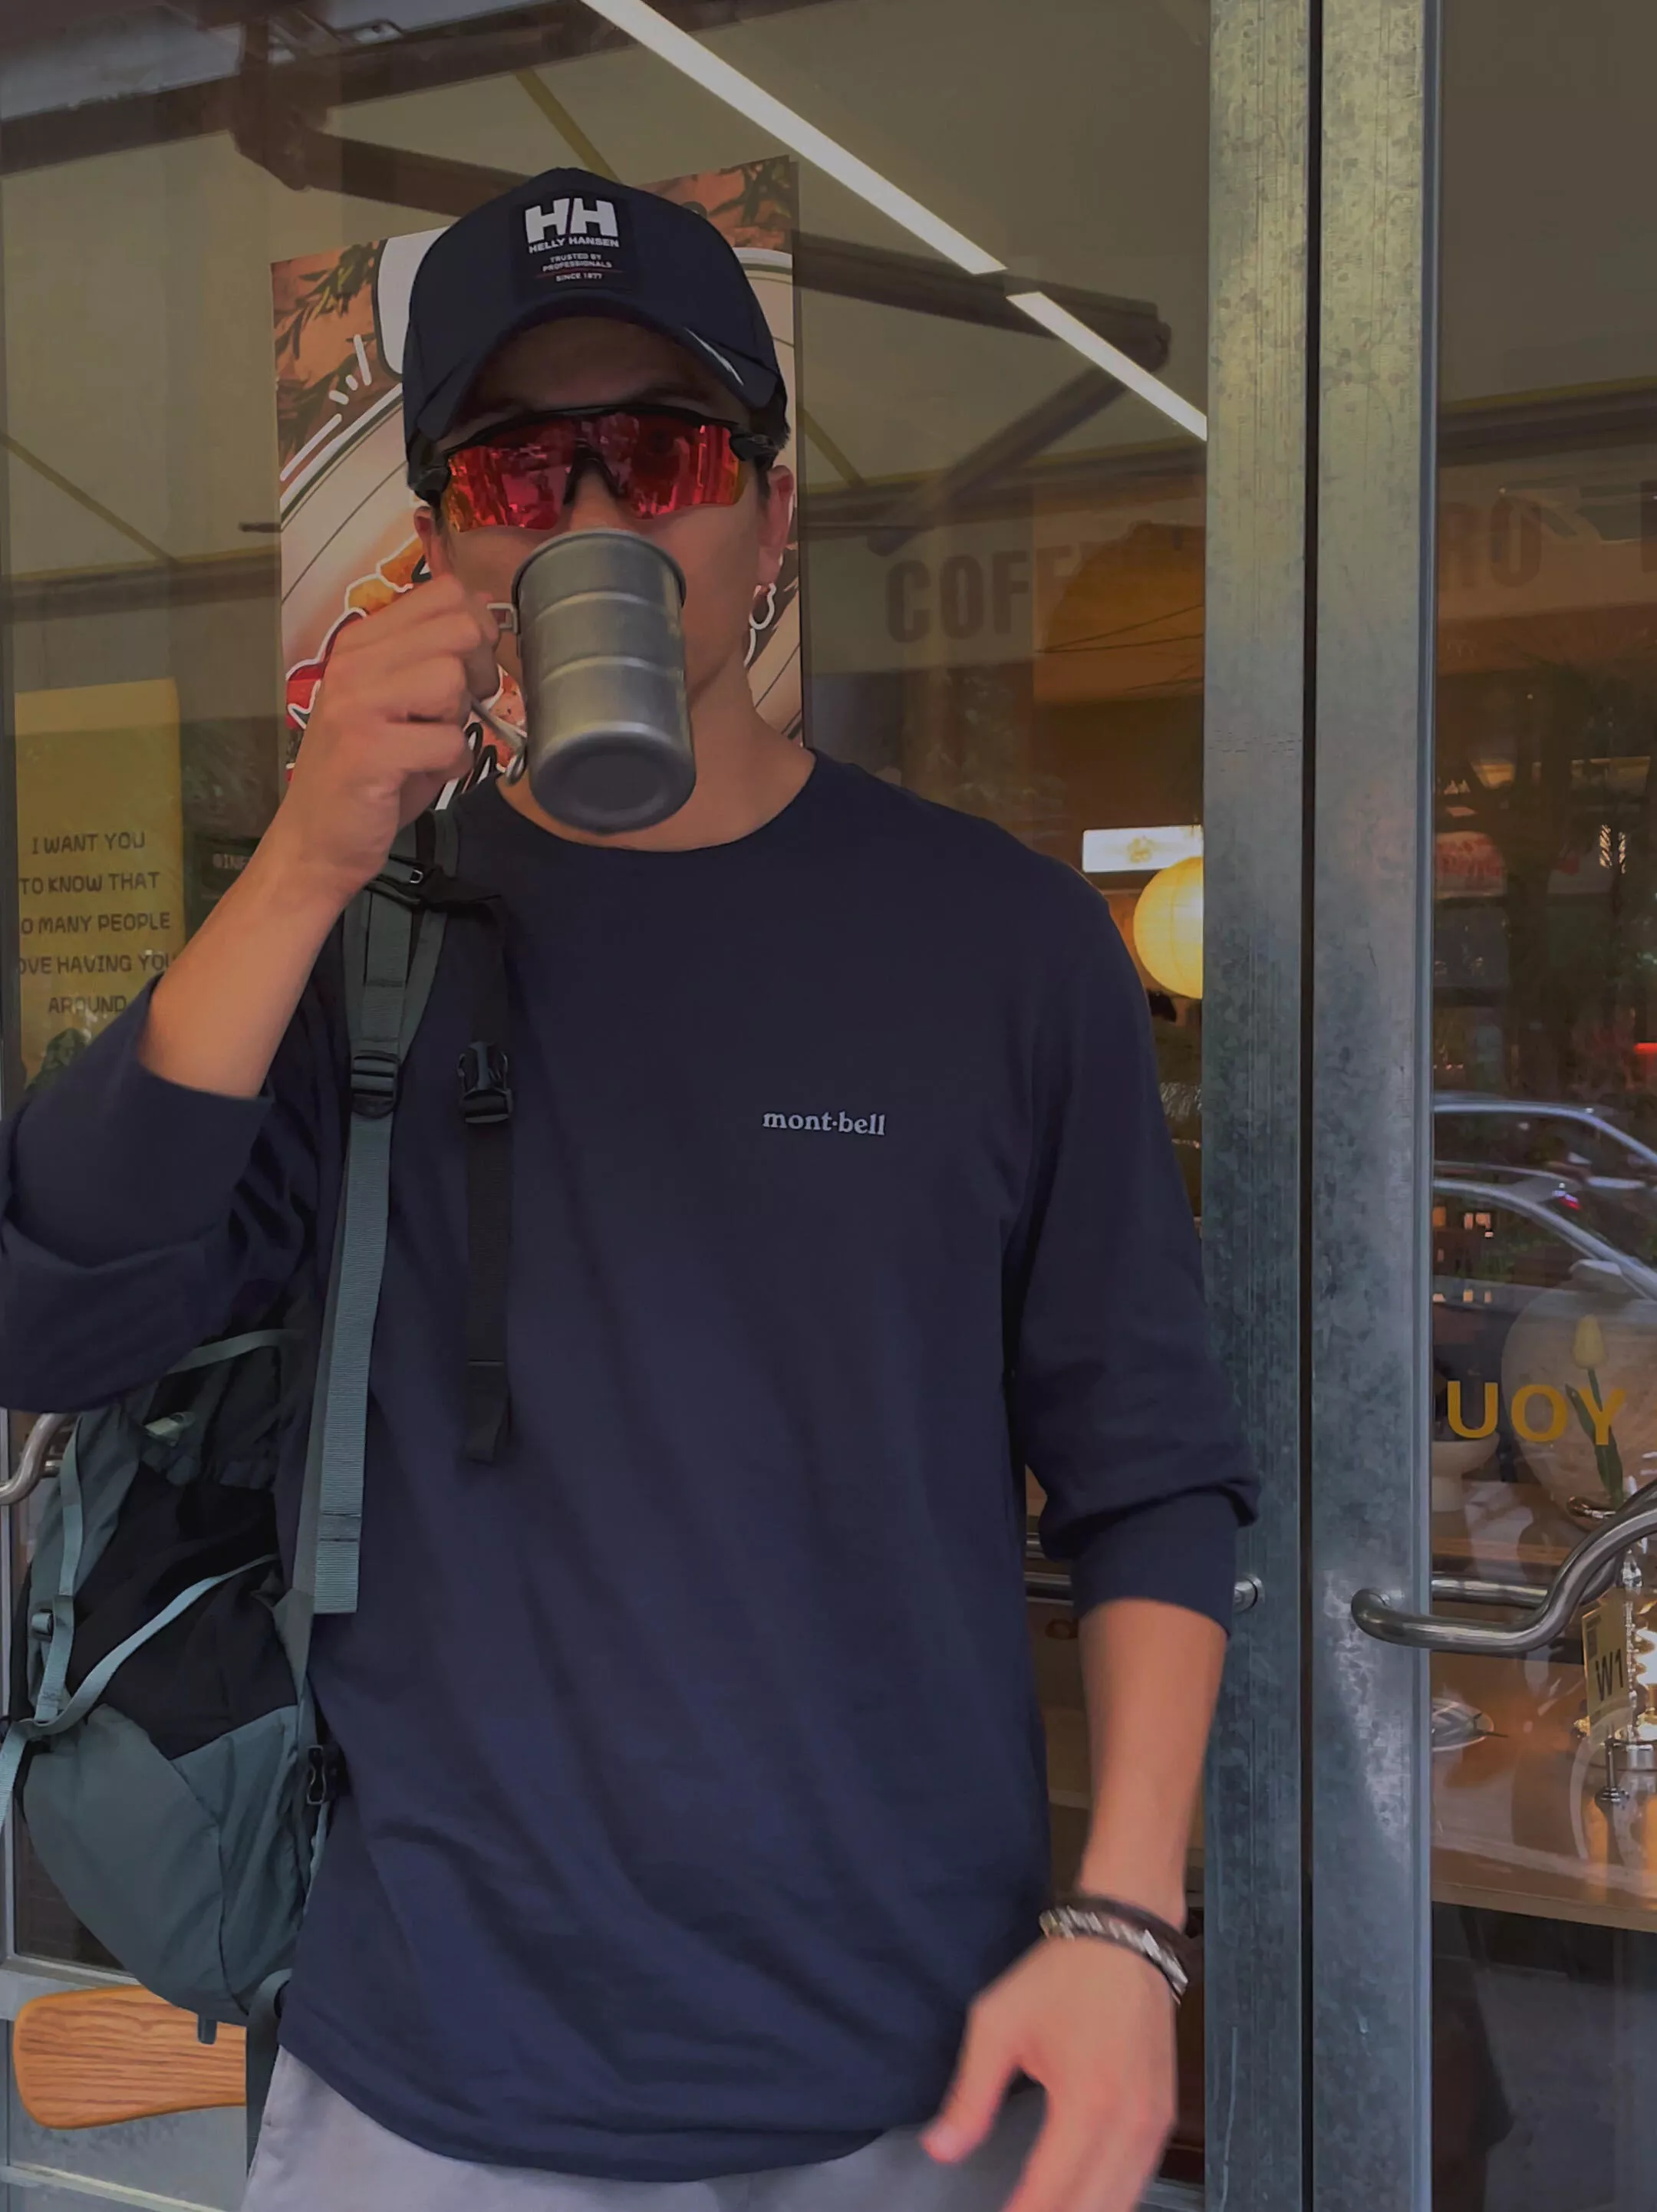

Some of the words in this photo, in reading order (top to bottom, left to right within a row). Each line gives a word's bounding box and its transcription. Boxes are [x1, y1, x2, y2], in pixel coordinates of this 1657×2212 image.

[529, 239, 565, 253] HELLY
[568, 237, 620, 247] HANSEN
[542, 261, 612, 272] PROFESSIONALS
[550, 253, 588, 262] TRUSTED
[556, 273, 581, 281] SINCE
[32, 837, 38, 854] I
[44, 834, 99, 854] WANT
[105, 831, 146, 850] YOU
[19, 877, 44, 895] TO
[48, 874, 103, 894] KNOW
[108, 871, 160, 890] THAT
[19, 918, 34, 934] O
[39, 915, 92, 934] MANY
[98, 912, 170, 932] PEOPLE
[19, 956, 51, 975] OVE
[58, 954, 132, 974] HAVING
[48, 996, 127, 1014] AROUND
